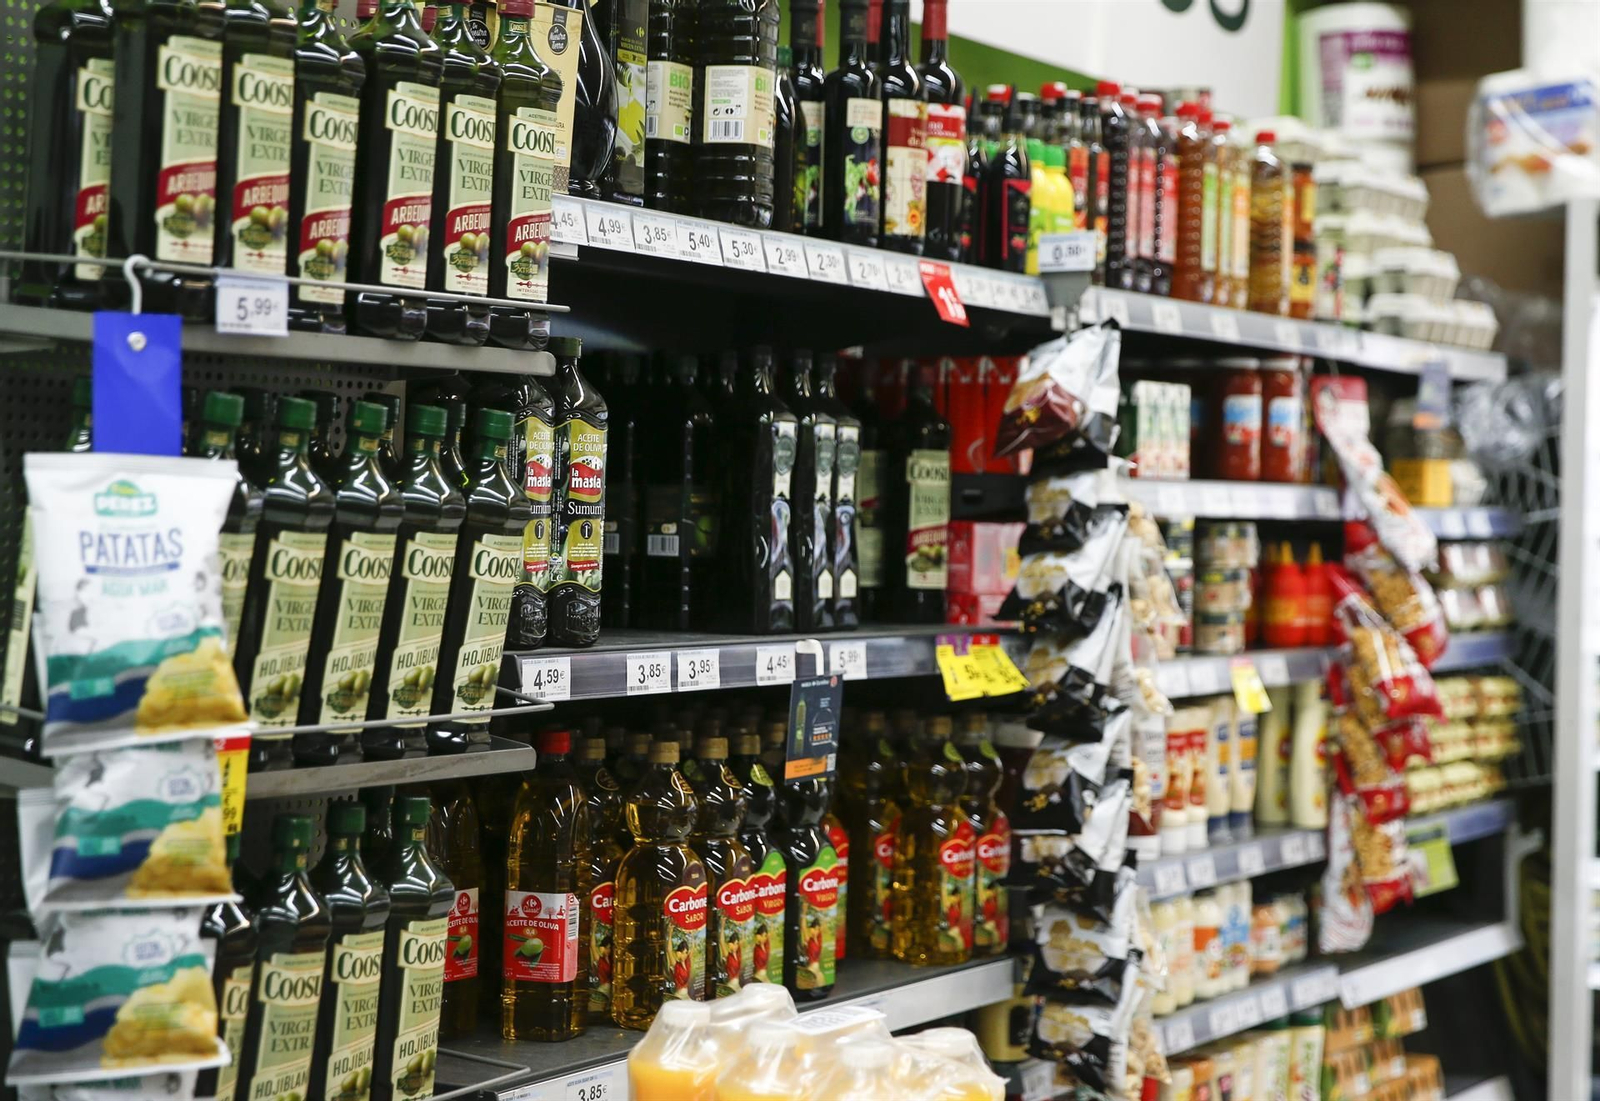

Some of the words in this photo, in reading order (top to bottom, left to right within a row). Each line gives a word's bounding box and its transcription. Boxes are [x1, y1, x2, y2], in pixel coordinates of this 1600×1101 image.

[577, 433, 600, 443] ACEITE
[573, 443, 584, 452] DE
[585, 443, 602, 452] OLIVA
[571, 467, 579, 477] la
[530, 505, 551, 515] umum
[568, 502, 602, 515] Sumum
[79, 528, 183, 563] PATATAS
[534, 668, 565, 690] 4,59€
[638, 664, 667, 684] 3,85€
[449, 917, 462, 928] CEITE
[528, 920, 538, 928] DE
[539, 921, 560, 931] OLIVA
